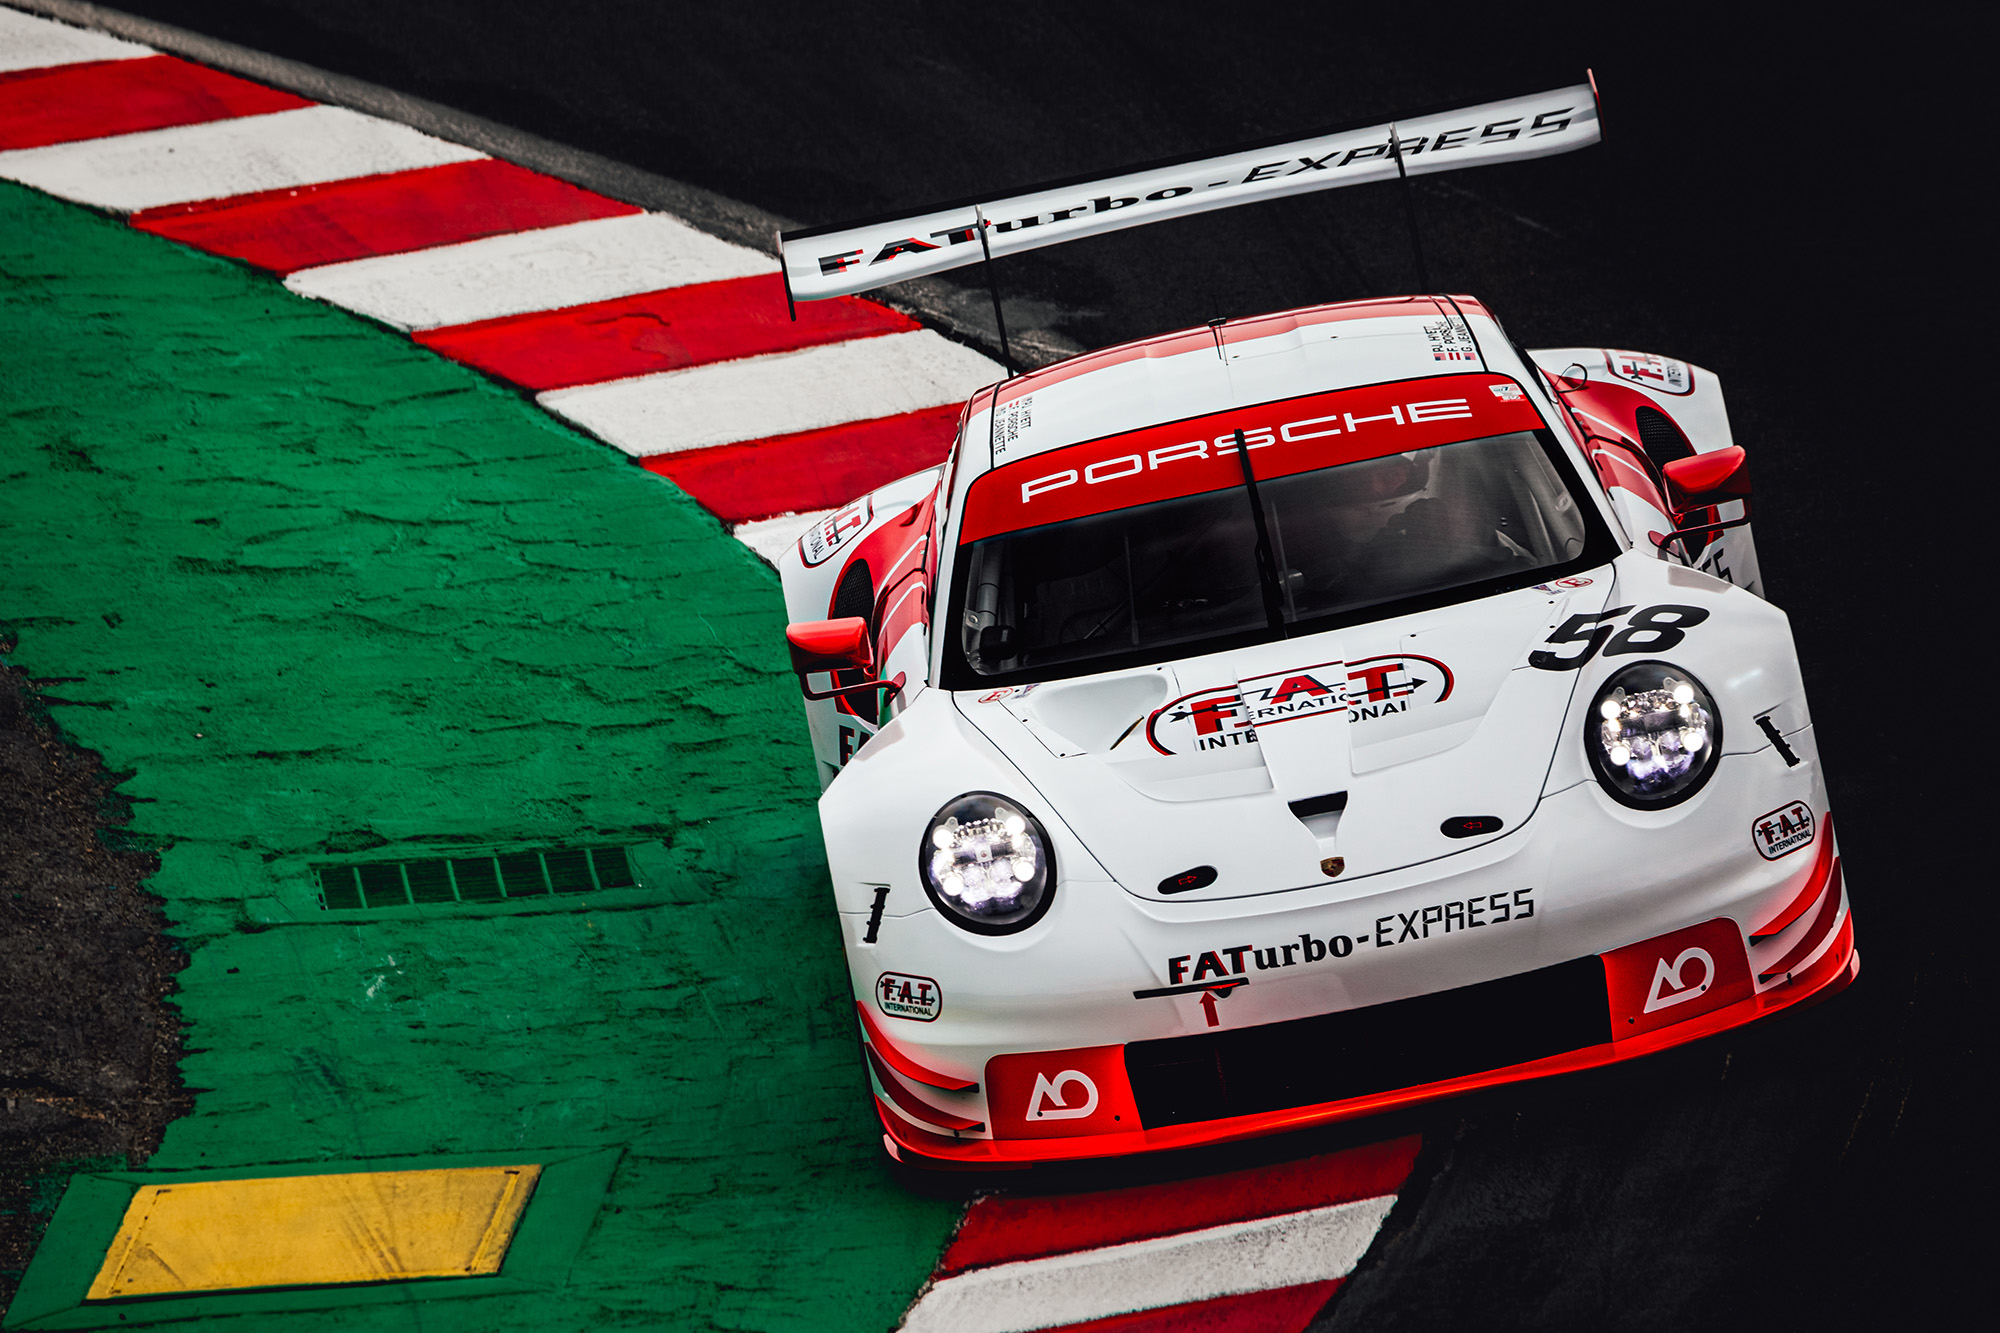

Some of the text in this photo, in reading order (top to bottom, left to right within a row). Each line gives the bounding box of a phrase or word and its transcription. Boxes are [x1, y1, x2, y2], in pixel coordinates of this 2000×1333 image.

[1021, 398, 1474, 504] PORSCHE
[1528, 604, 1710, 671] 58
[1768, 828, 1812, 855] INTERNATIONAL
[1167, 887, 1535, 986] FATurbo-EXPRESS
[884, 1001, 934, 1017] INTERNATIONAL
